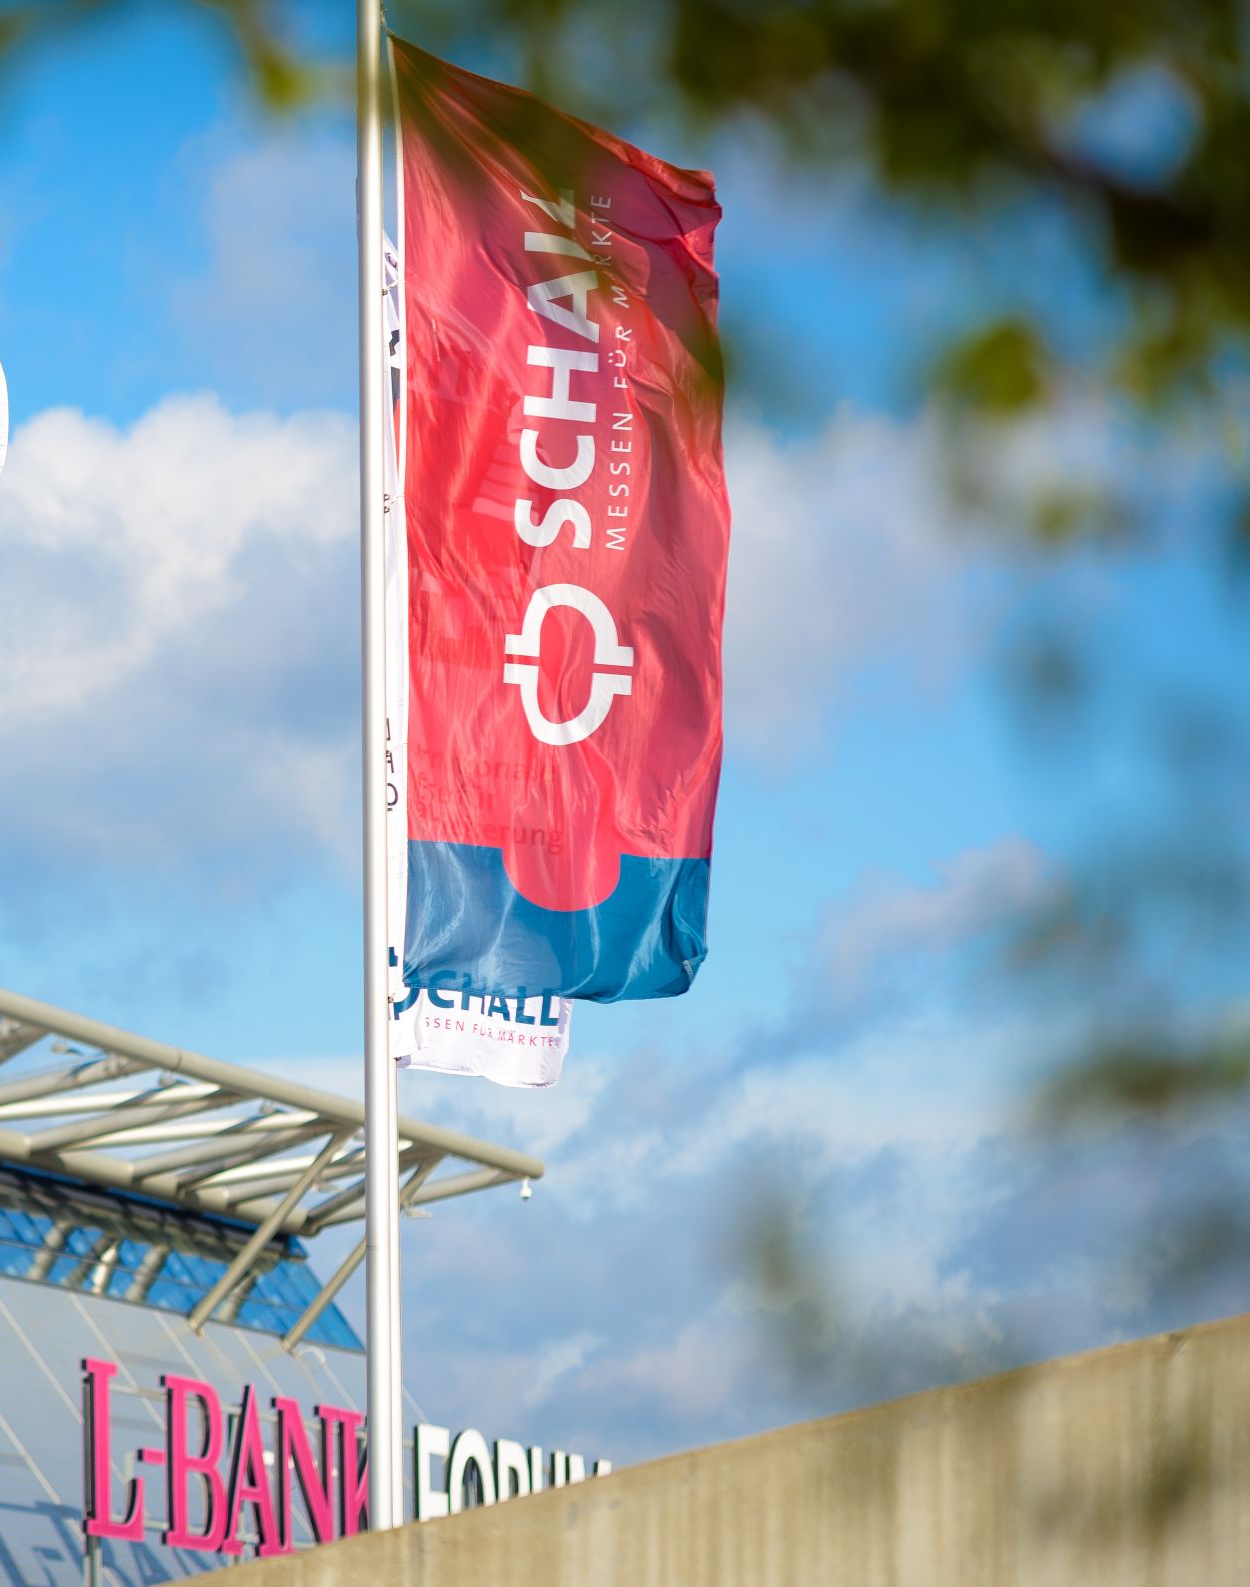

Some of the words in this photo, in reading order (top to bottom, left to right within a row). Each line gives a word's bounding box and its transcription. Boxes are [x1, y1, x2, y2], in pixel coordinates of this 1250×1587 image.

[590, 195, 631, 308] MRKTE
[608, 325, 633, 389] FÜR
[605, 413, 634, 551] MESSEN
